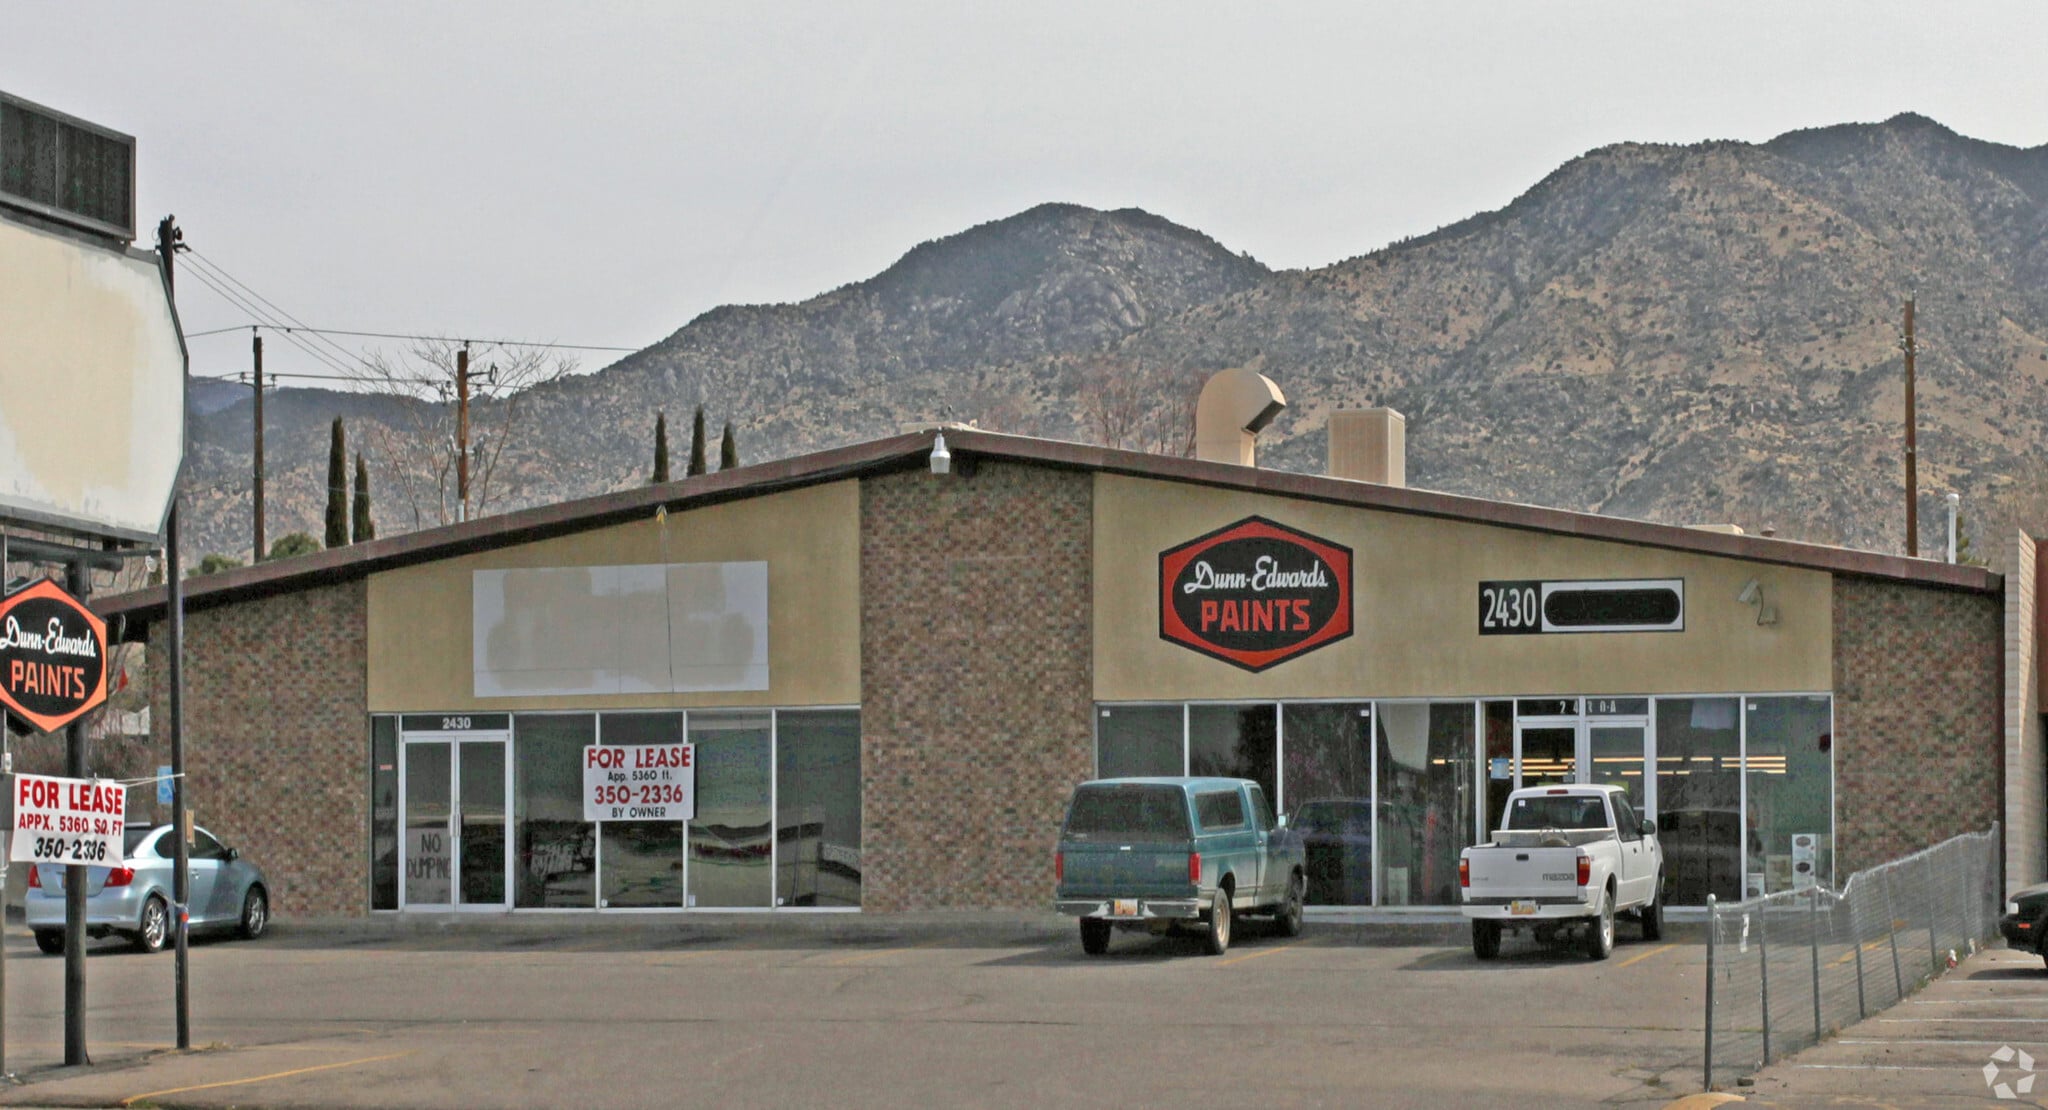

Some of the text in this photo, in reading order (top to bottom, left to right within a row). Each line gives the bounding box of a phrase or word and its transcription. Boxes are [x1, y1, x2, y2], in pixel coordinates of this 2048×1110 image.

[1183, 555, 1328, 594] Dunn-Edwards
[1201, 599, 1310, 632] PAINTS
[1483, 587, 1536, 628] 2430
[0, 615, 97, 658] Dunn-Edwards
[11, 659, 86, 699] PAINTS
[442, 717, 472, 729] 2430
[587, 747, 691, 769] FOR LEASE
[632, 770, 658, 781] 5360
[20, 779, 123, 815] FOR LEASE
[594, 784, 683, 805] 350-2336
[612, 806, 666, 818] BY OWNER
[19, 813, 54, 831] APPX.
[59, 816, 89, 833] 5360
[112, 820, 123, 836] FT
[34, 837, 106, 861] 350-2336
[421, 832, 442, 854] NO
